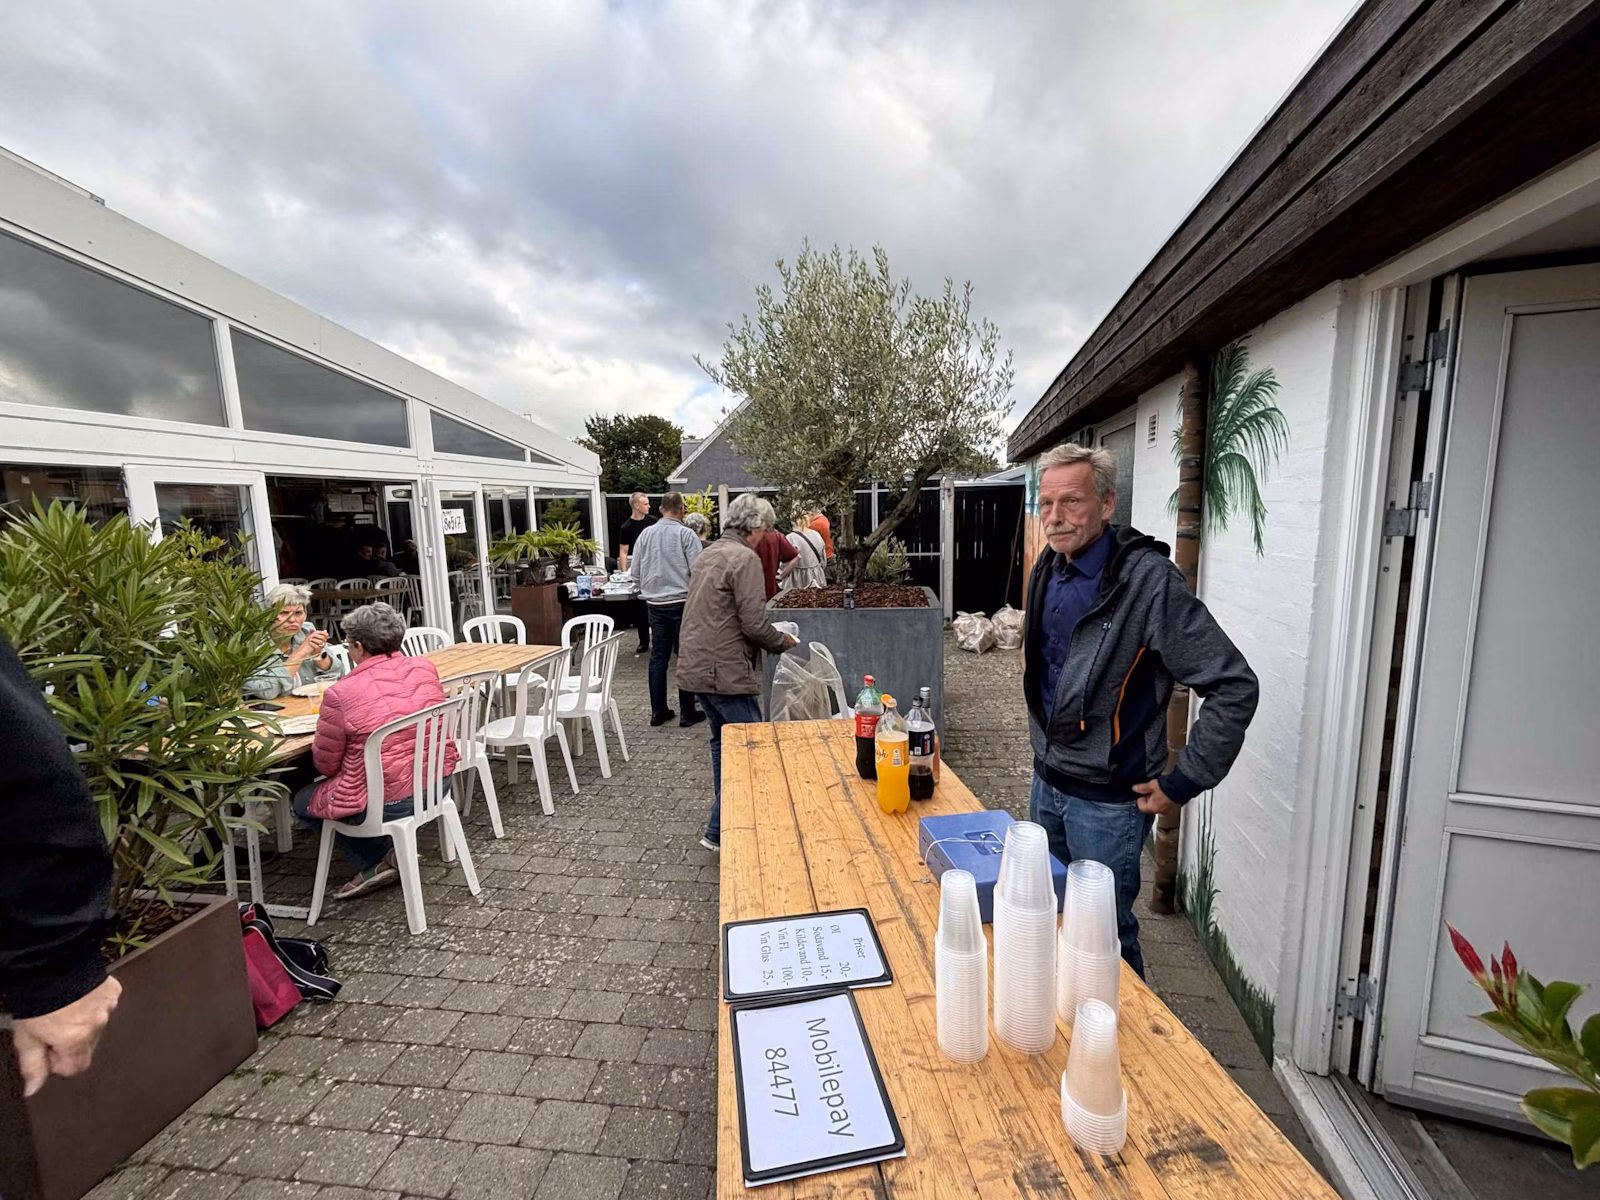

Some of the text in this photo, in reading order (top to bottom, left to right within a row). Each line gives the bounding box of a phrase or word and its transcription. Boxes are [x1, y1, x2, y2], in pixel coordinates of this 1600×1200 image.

[760, 931, 774, 986] Vin Glas 25,-
[777, 927, 788, 941] Vin
[795, 928, 813, 982] Kildevand 10,-
[812, 926, 832, 980] Sodavand 15,-
[830, 924, 851, 978] Øl 20,-
[853, 937, 865, 959] Priser
[781, 966, 794, 986] 100,-
[765, 1047, 799, 1117] 84477
[806, 1017, 855, 1137] Mobilepay
